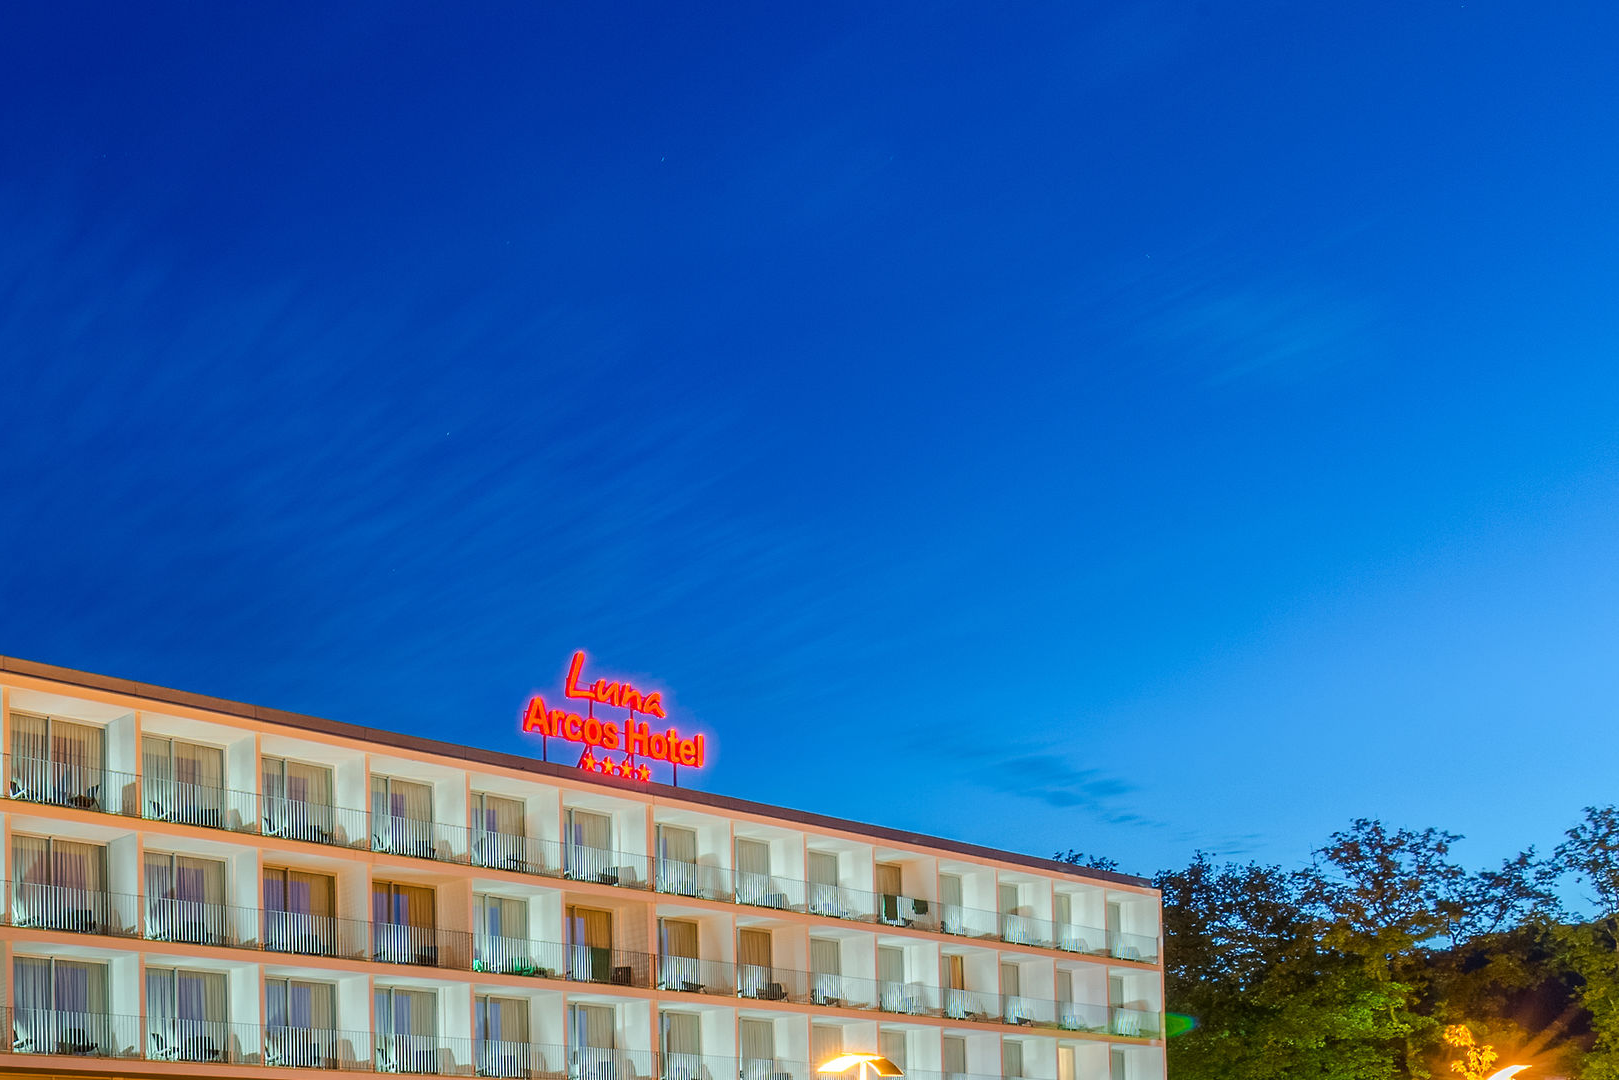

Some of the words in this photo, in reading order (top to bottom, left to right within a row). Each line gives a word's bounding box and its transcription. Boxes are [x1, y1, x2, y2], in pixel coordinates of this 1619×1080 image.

[565, 650, 666, 718] Luna
[523, 695, 620, 750] Arcos
[624, 717, 705, 769] Hotel
